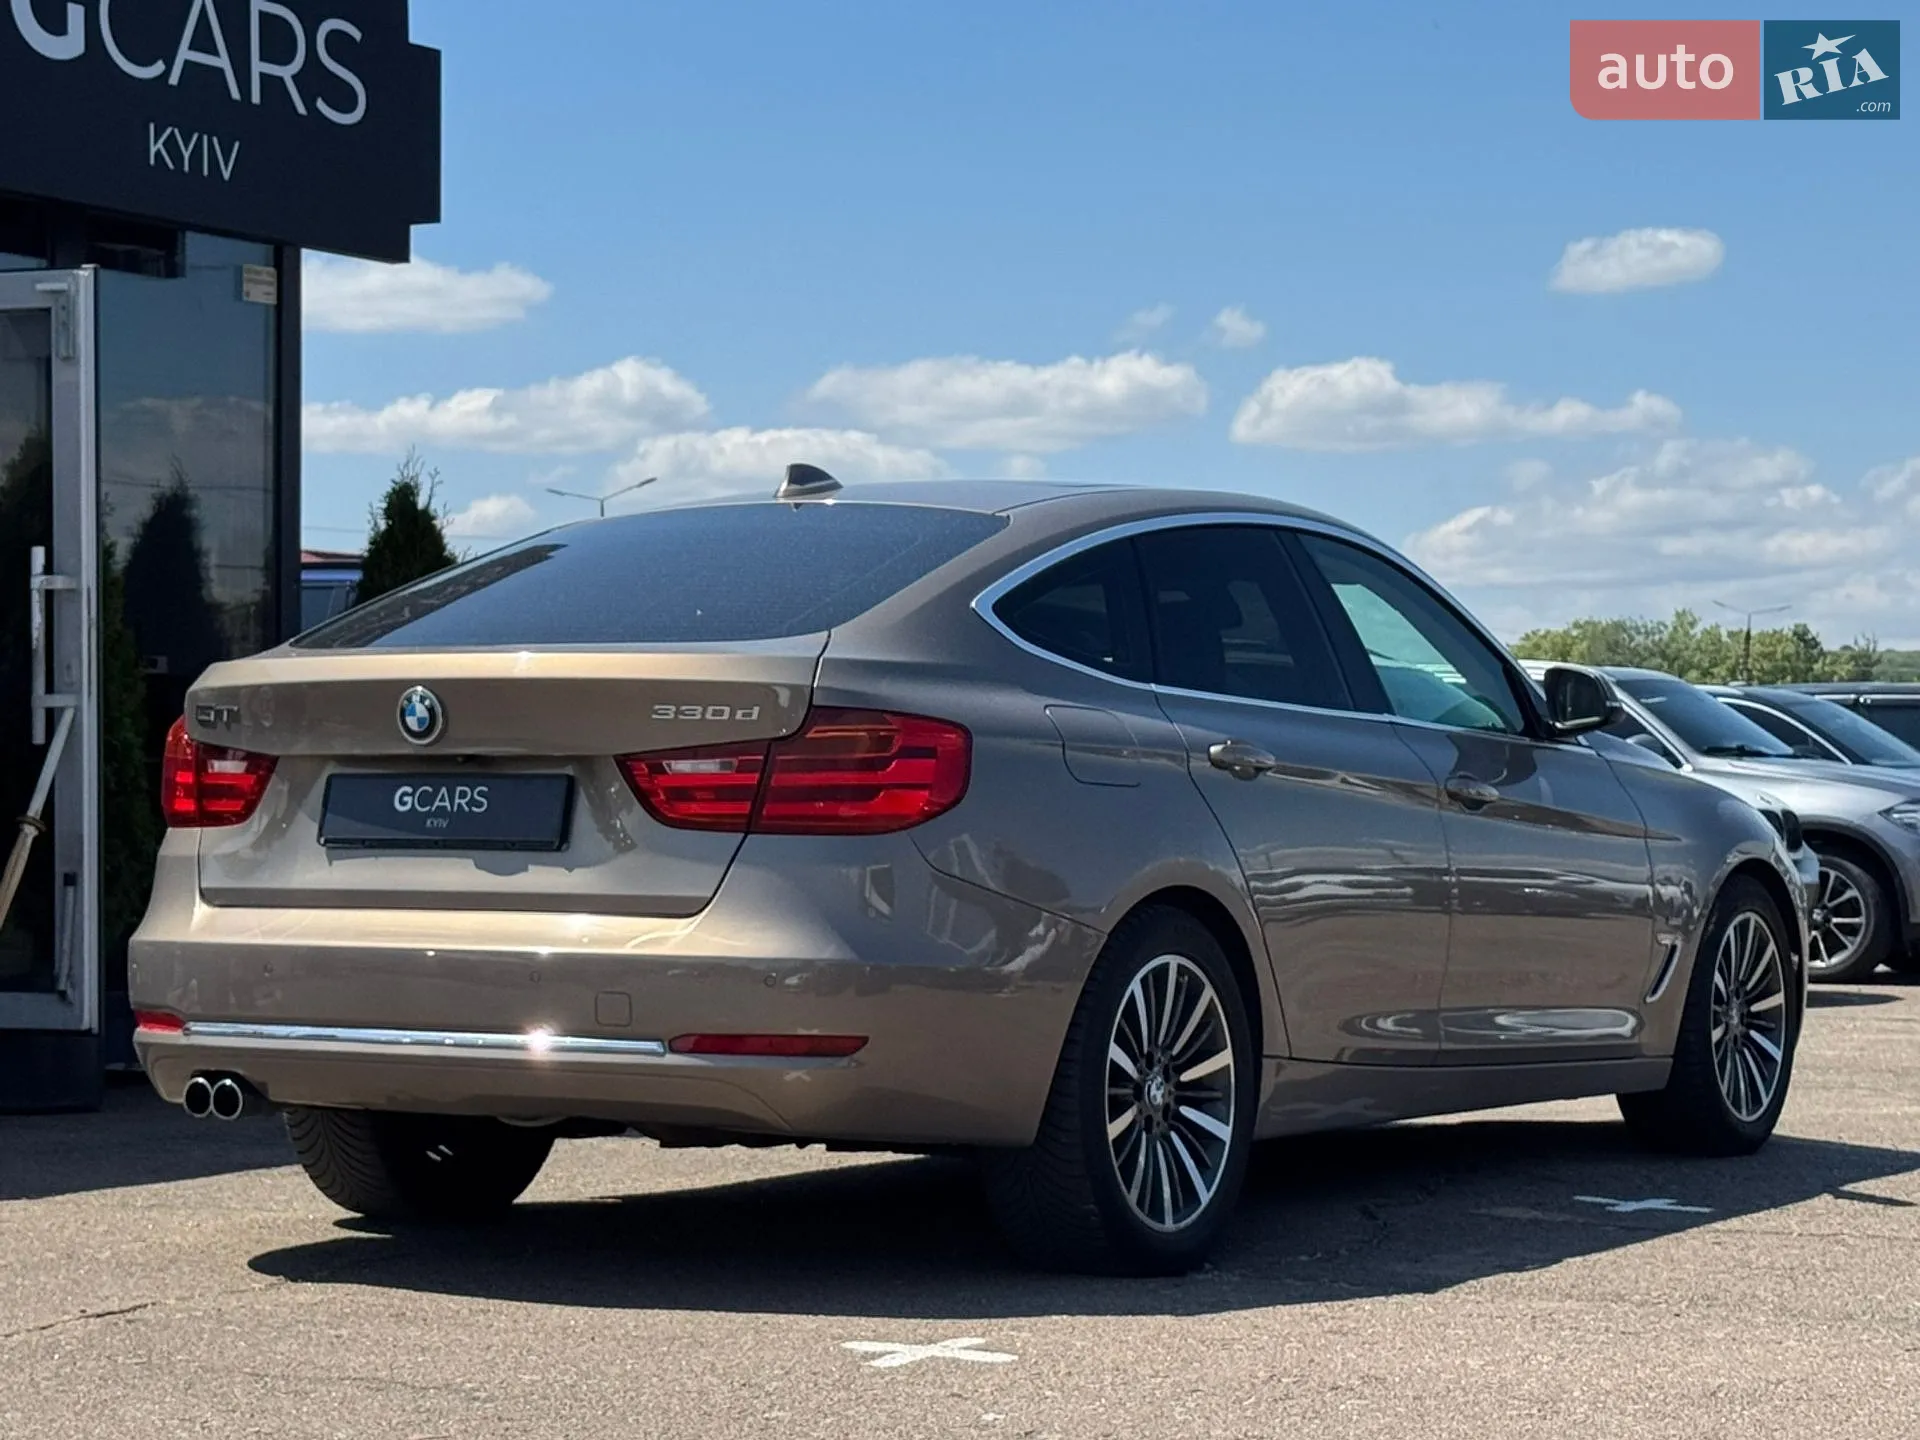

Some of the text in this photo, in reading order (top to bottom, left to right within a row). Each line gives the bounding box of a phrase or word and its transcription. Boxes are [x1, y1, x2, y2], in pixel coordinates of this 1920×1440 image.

[148, 122, 241, 182] KYIV
[651, 705, 760, 721] 330d
[393, 785, 489, 813] GCARS
